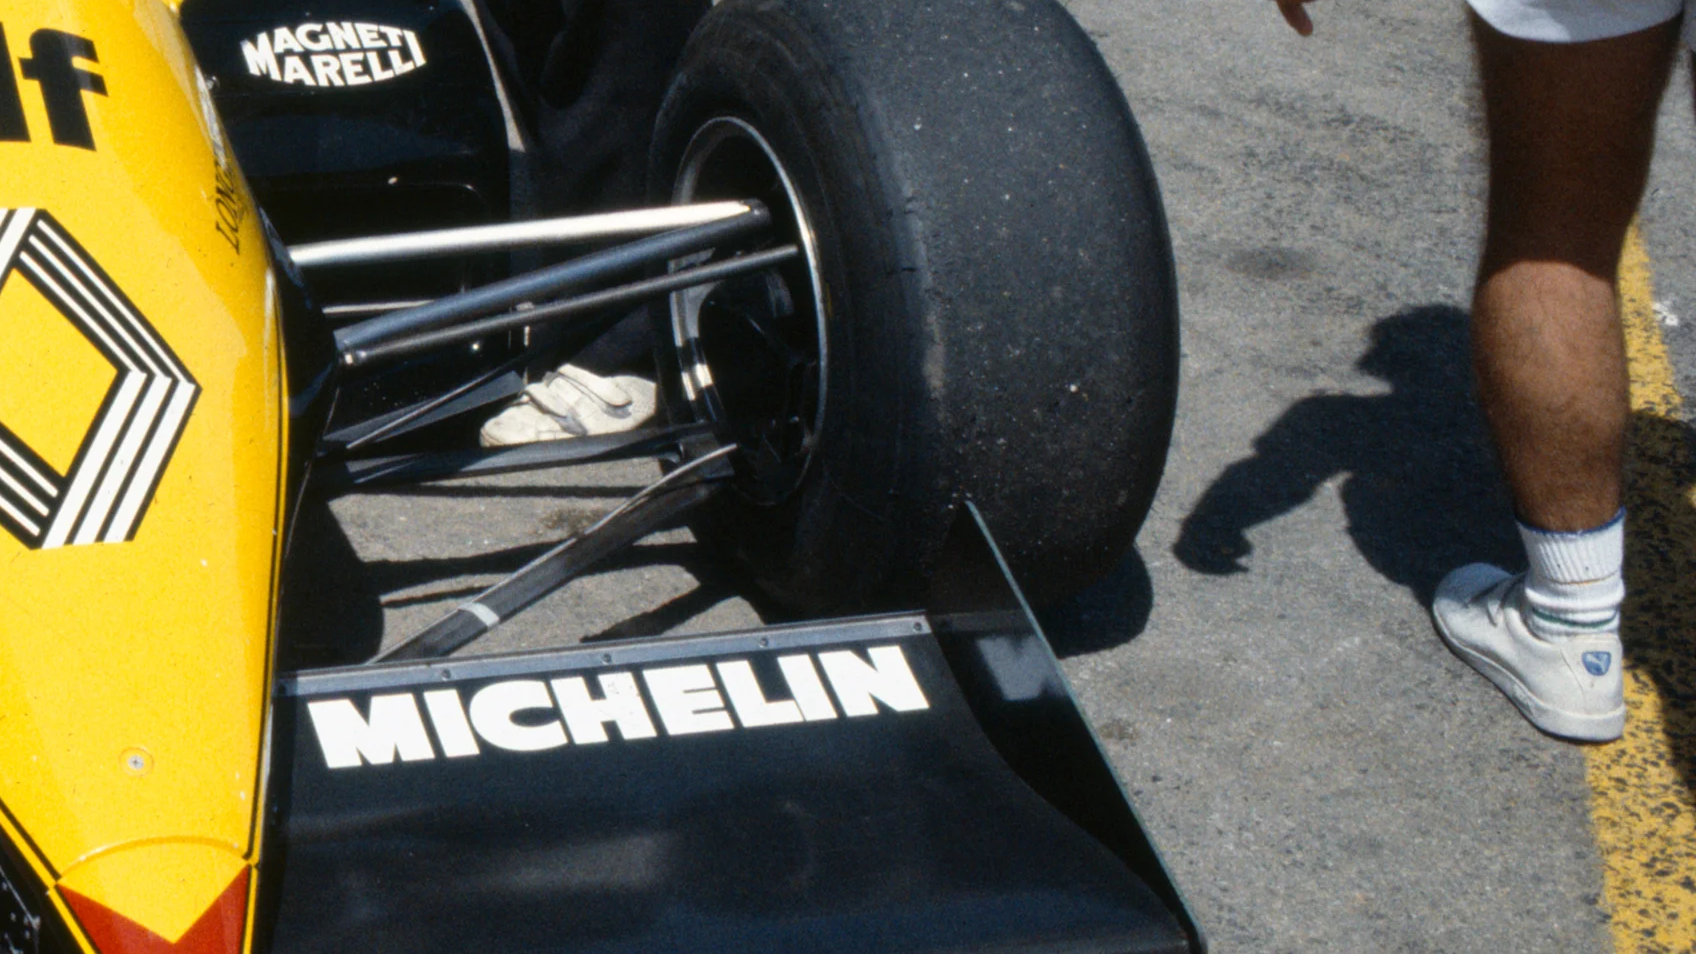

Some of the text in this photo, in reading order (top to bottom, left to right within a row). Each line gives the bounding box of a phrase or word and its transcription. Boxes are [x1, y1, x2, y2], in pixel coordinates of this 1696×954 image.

[240, 22, 427, 63] MAGNETI
[241, 47, 427, 87] MARELLI
[307, 644, 931, 770] MICHELIN
